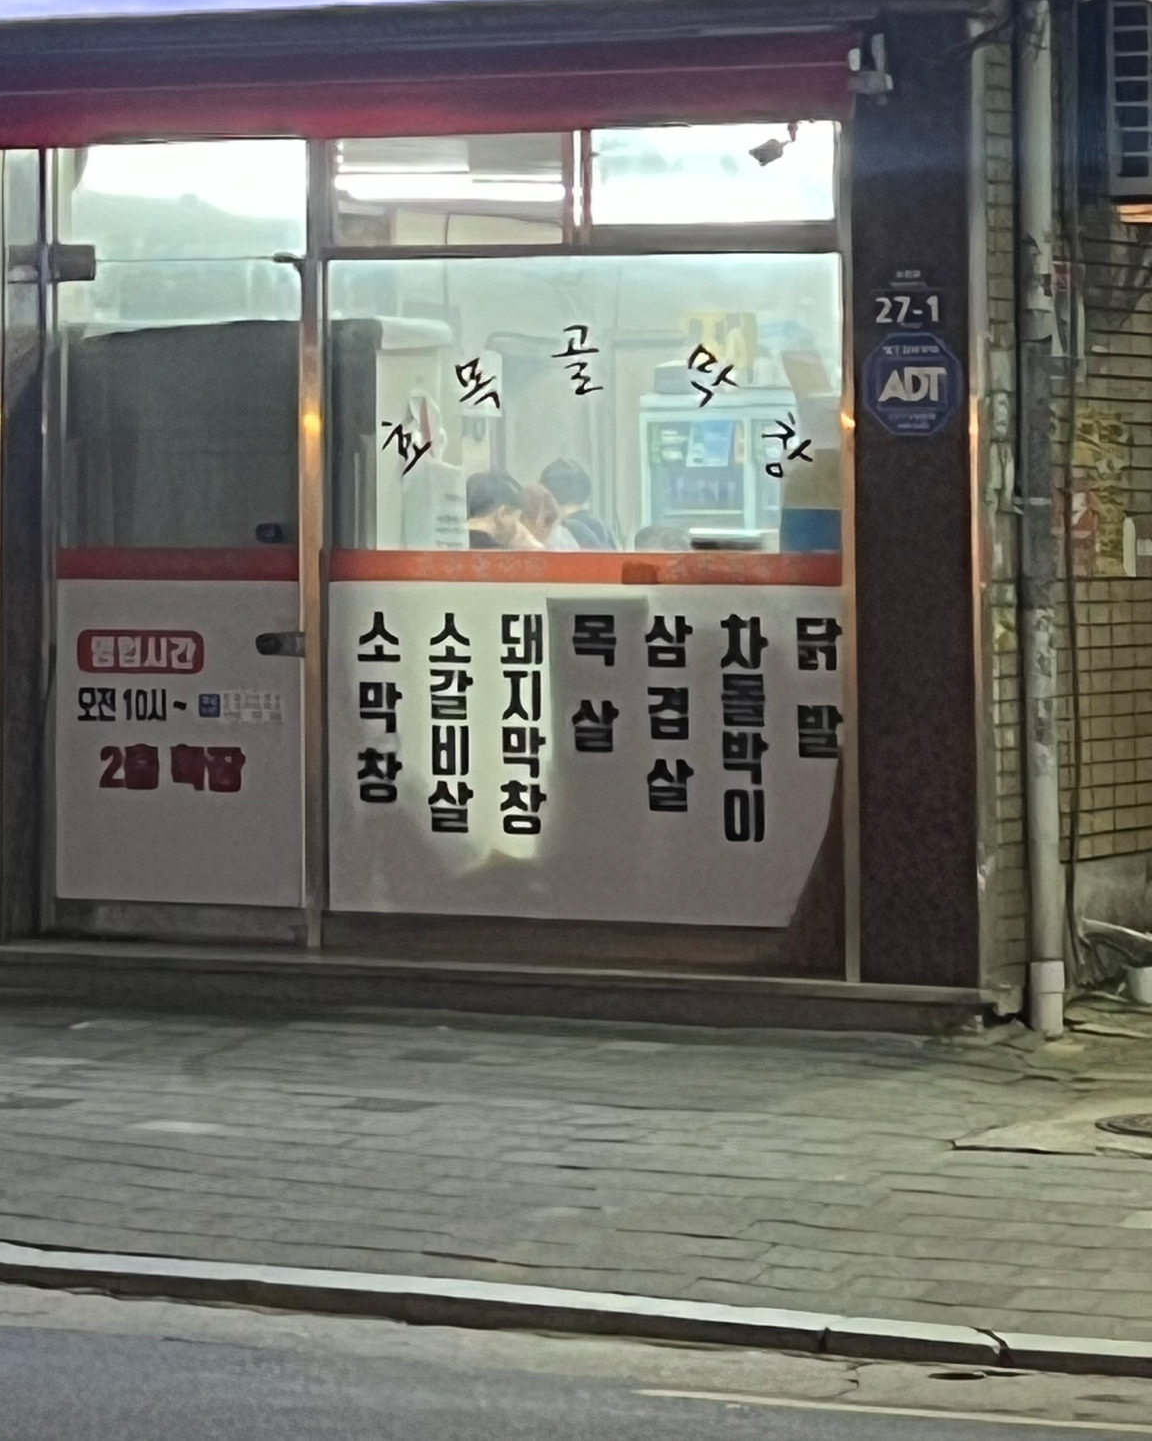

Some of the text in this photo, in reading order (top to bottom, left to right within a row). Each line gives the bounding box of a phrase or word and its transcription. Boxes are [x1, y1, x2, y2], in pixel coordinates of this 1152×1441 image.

[875, 295, 939, 324] 27-1
[878, 366, 948, 402] ADT
[77, 687, 116, 722] 오전
[91, 635, 196, 670] 영업시간
[357, 611, 403, 803] 소막창
[428, 612, 474, 833] 소갈비살
[571, 614, 620, 753] 목살
[795, 617, 843, 759] 닭발
[500, 613, 547, 834] 돼지막창
[720, 613, 769, 843] 차돌박이
